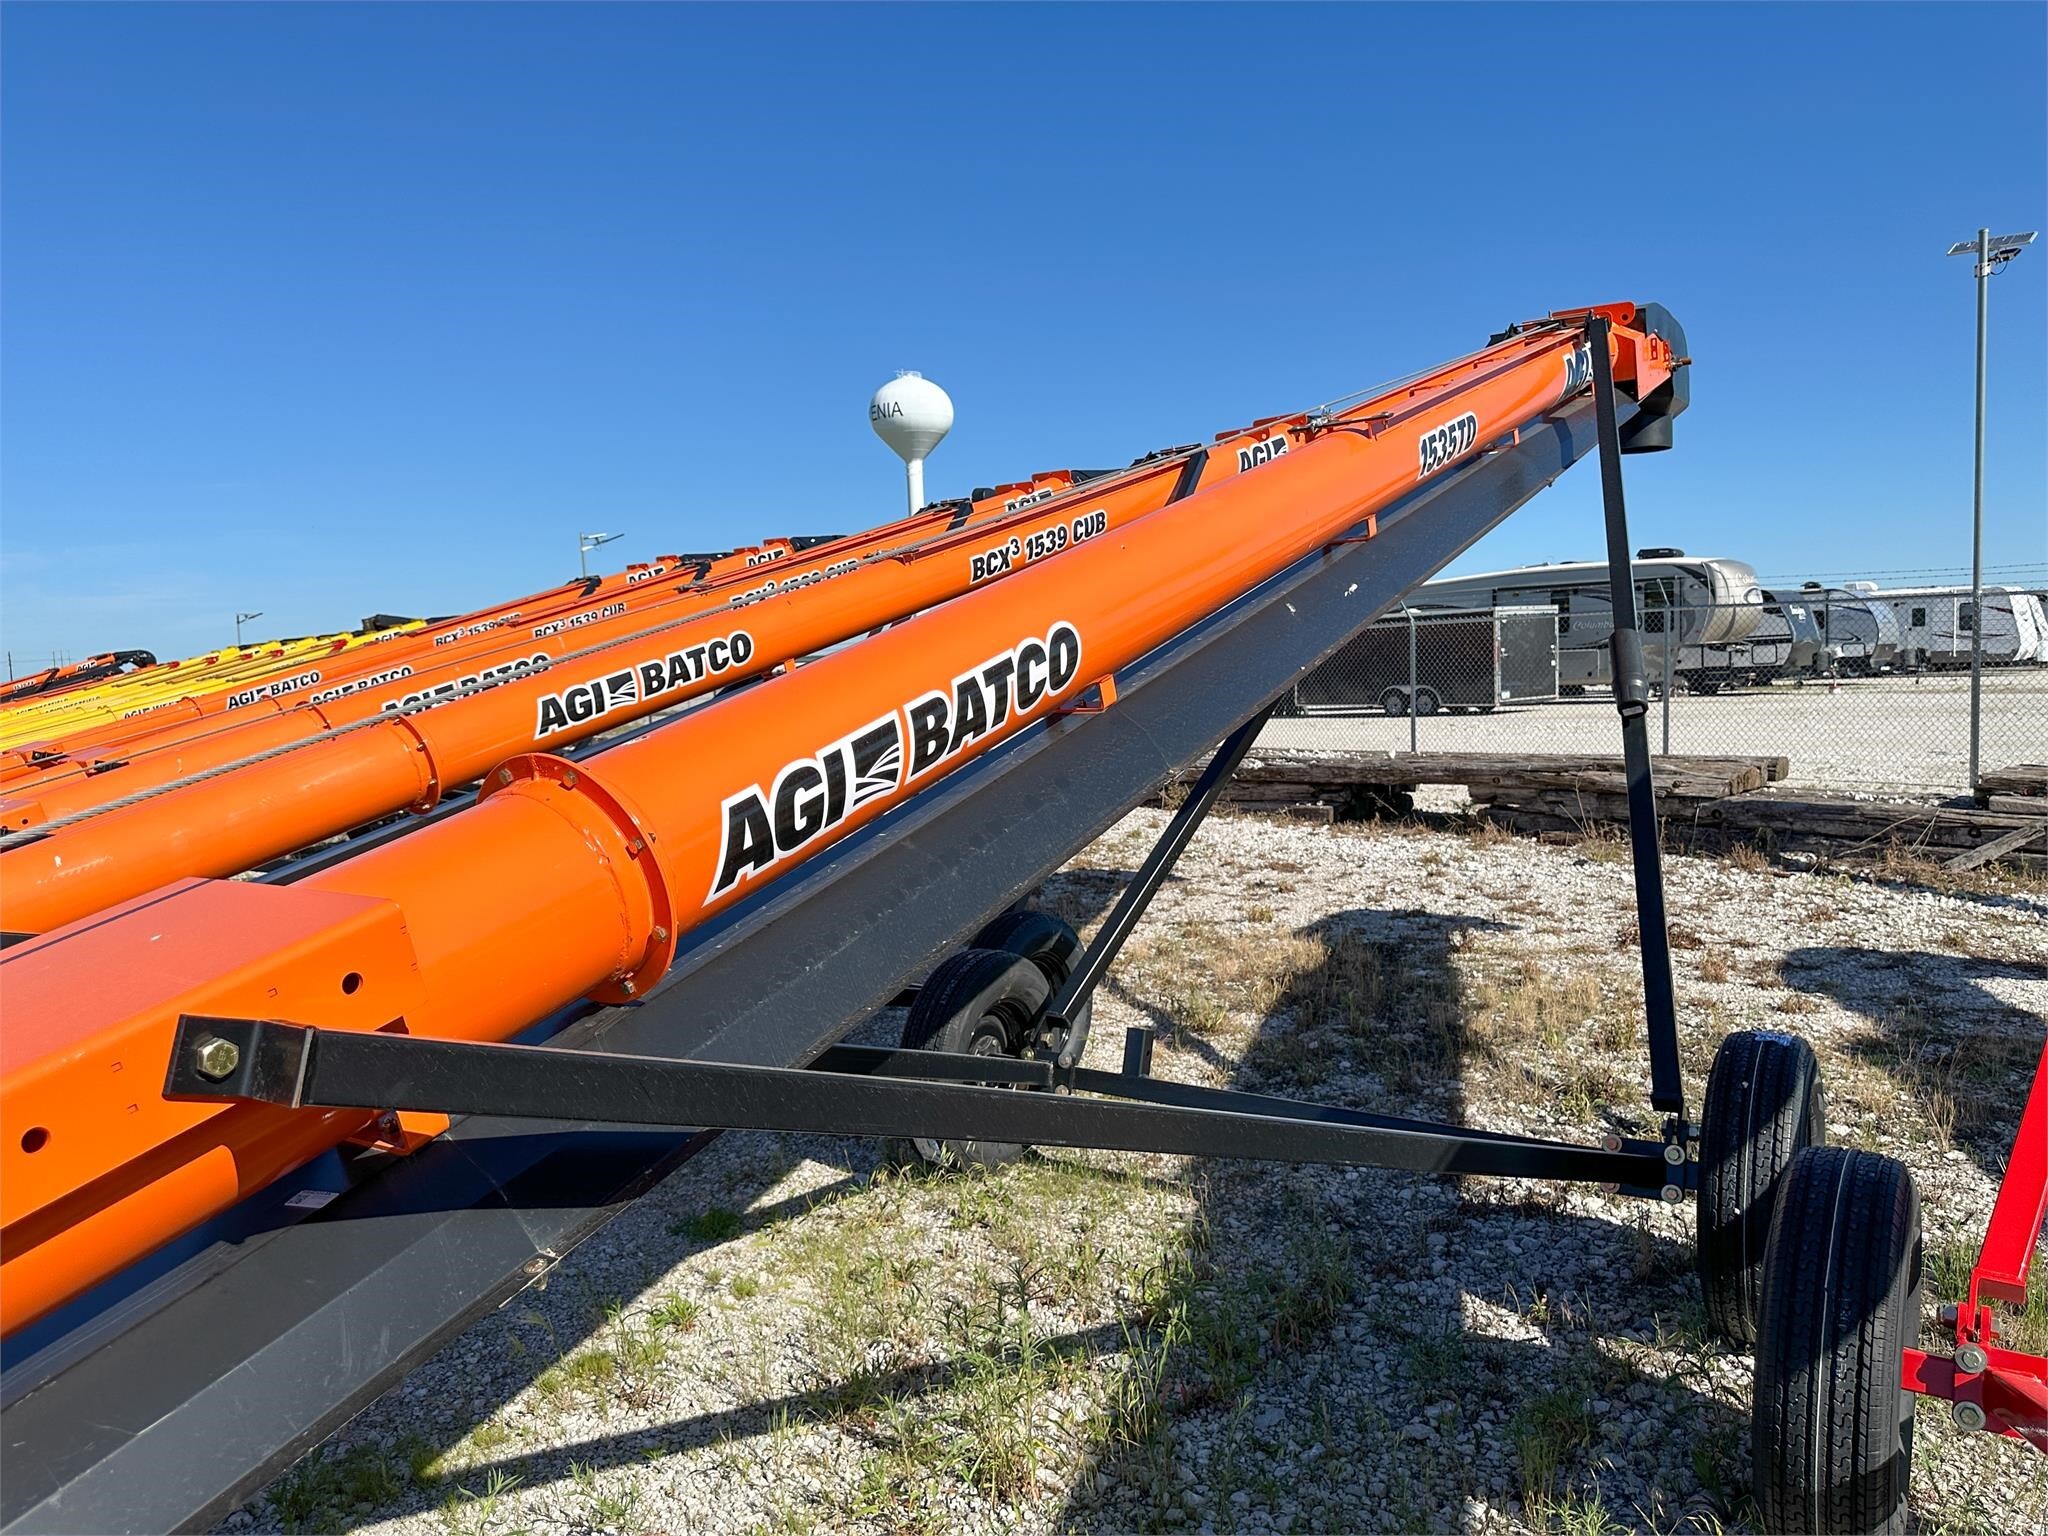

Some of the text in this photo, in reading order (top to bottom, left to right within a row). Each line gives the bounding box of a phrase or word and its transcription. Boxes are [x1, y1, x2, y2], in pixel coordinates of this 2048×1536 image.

[1239, 442, 1272, 473] AGI
[1419, 414, 1477, 477] 1535TD
[1026, 526, 1068, 560] 1539
[1073, 511, 1106, 543] CUB
[228, 692, 255, 710] AGI
[270, 671, 320, 696] BATCO
[539, 633, 752, 736] AGI BATCO
[712, 625, 1080, 896] AGI BATCO
